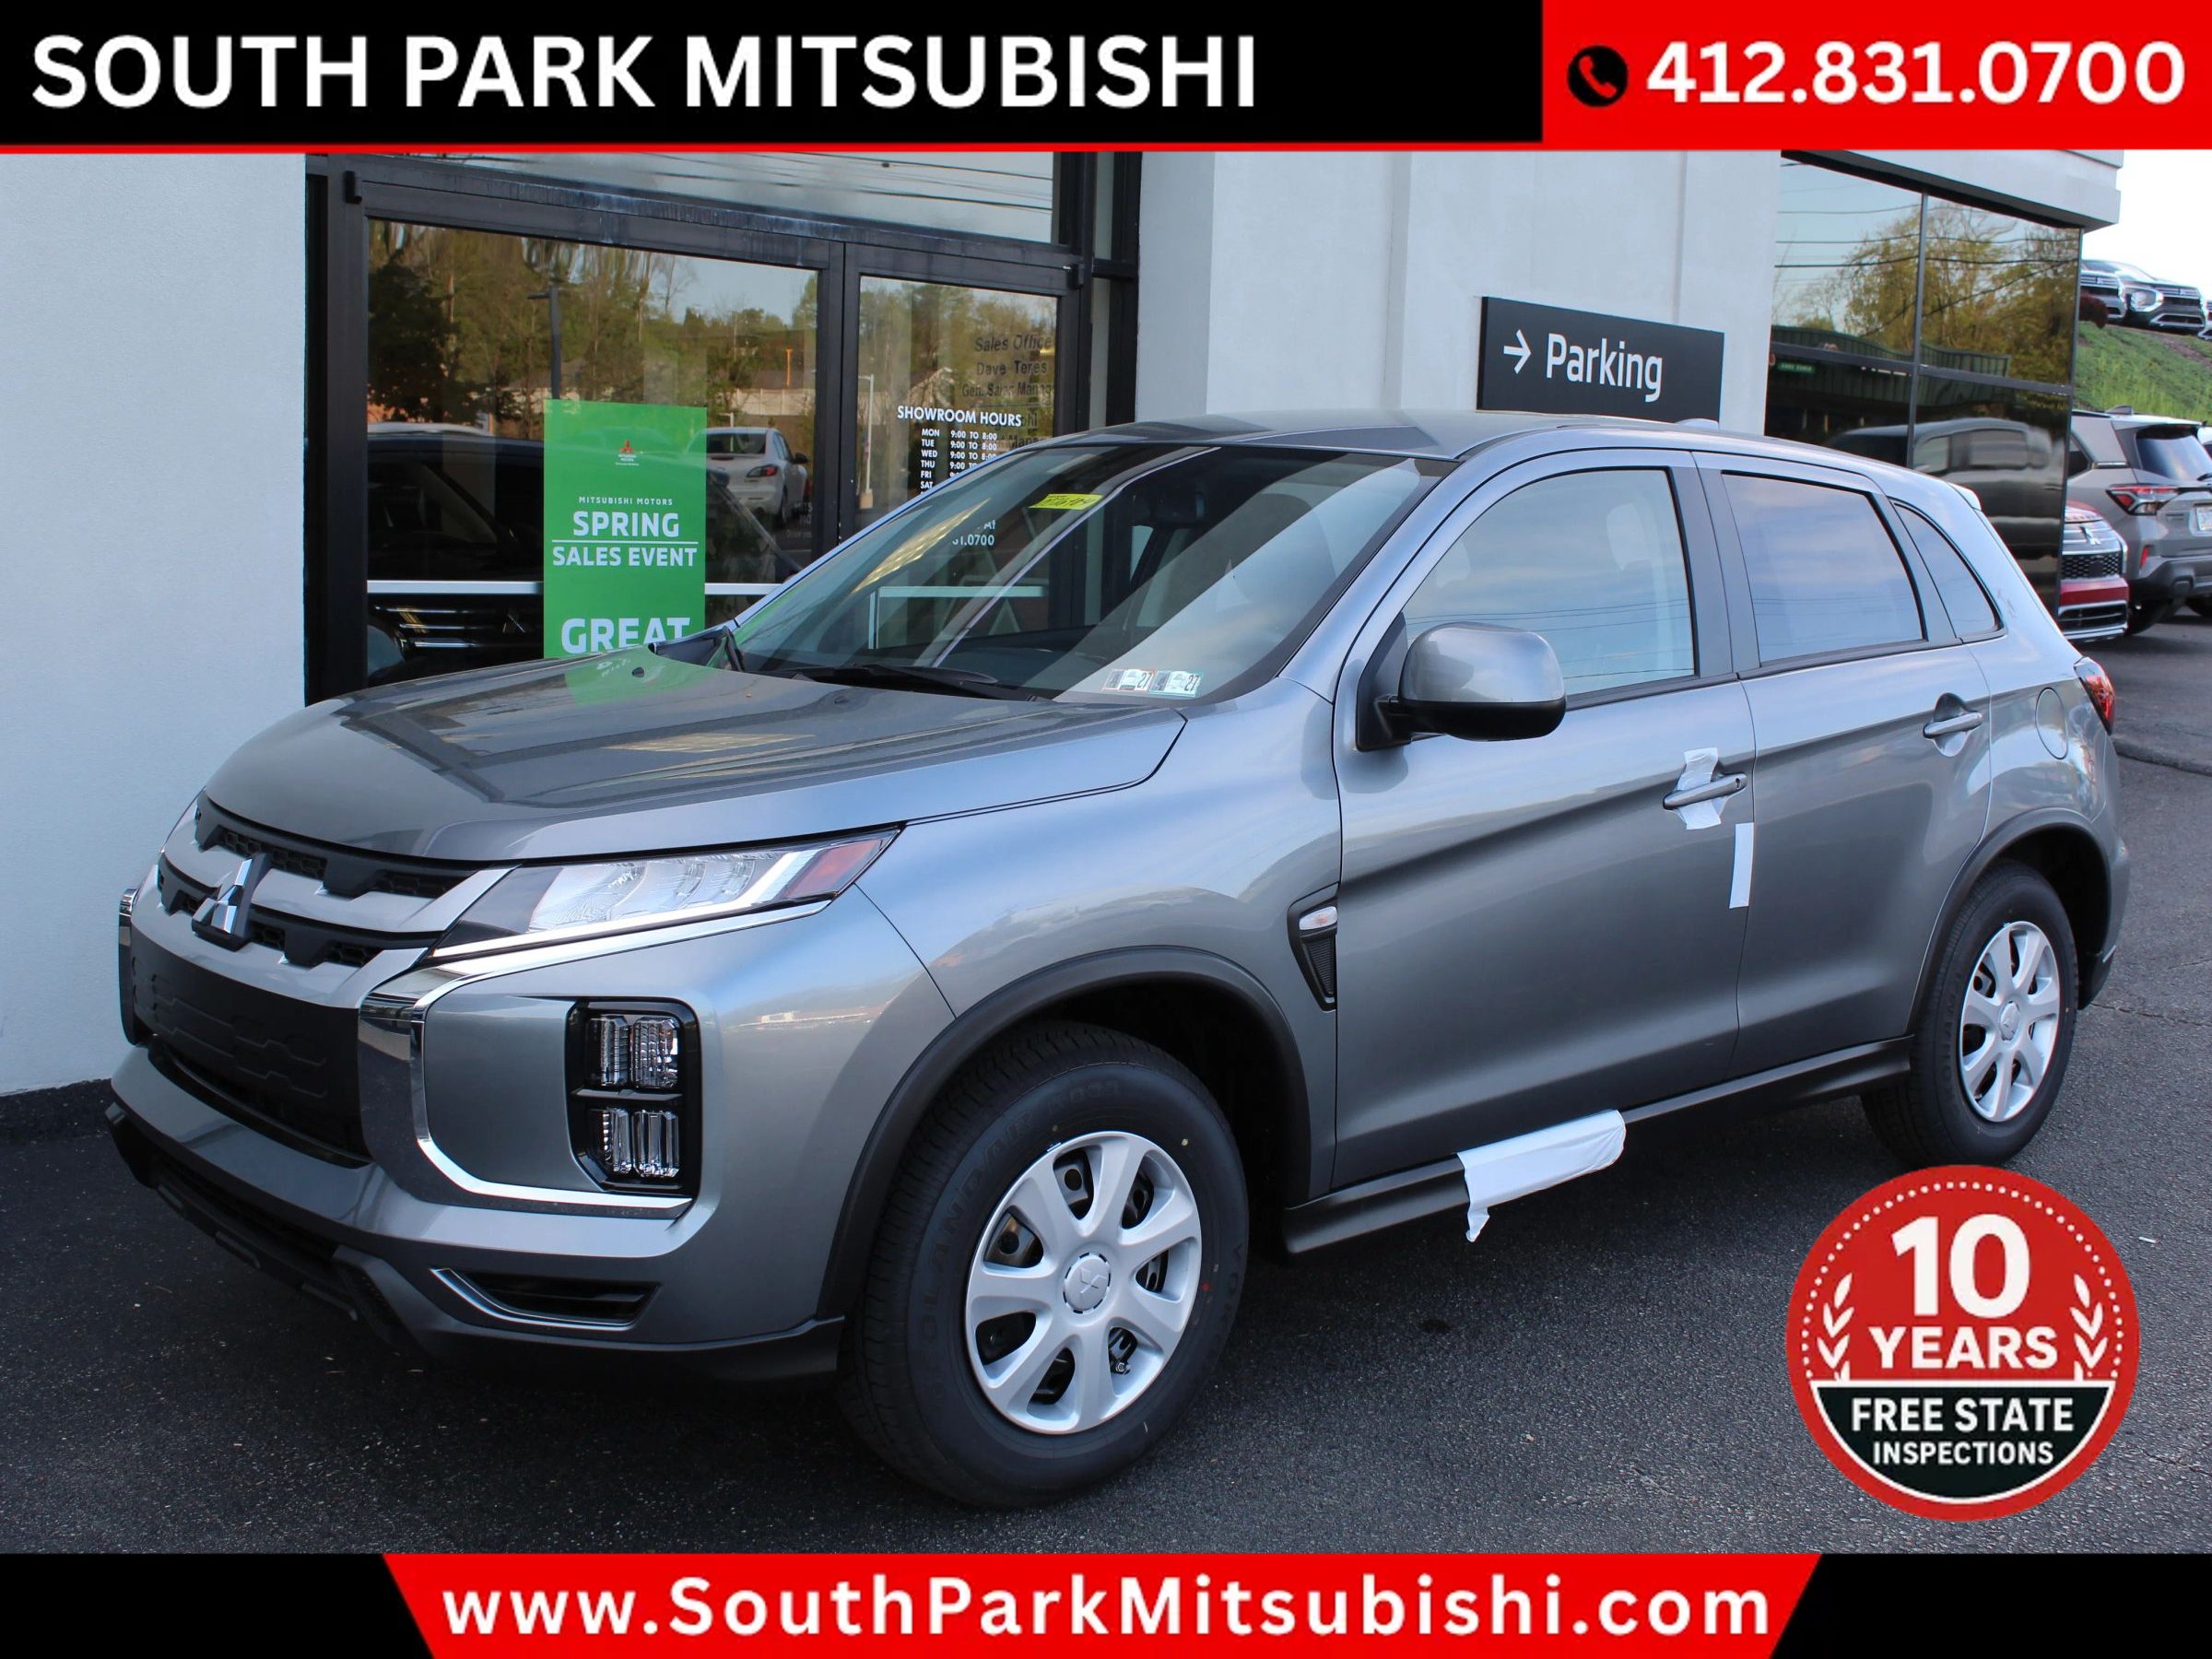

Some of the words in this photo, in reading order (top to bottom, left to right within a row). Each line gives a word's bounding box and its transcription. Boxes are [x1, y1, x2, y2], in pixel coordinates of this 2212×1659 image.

[974, 336, 1008, 352] Sales
[1013, 334, 1052, 350] Office
[977, 361, 1006, 376] Dave
[1546, 333, 1663, 403] Parking
[897, 405, 977, 424] SHOWROOM
[980, 411, 1022, 428] HOURS
[921, 429, 940, 437] MON
[950, 430, 966, 439] 9:00
[970, 431, 979, 440] TO
[982, 432, 997, 441] 8:00
[921, 439, 935, 447] TUE
[950, 441, 965, 449] 9:00
[969, 441, 978, 450] TO
[982, 442, 997, 451] 8:00
[921, 450, 938, 458] WED
[950, 451, 965, 460] 9:00
[968, 452, 978, 460] TO
[920, 460, 935, 468] THU
[949, 462, 965, 470] 9:00
[920, 470, 932, 478] FRI
[920, 481, 934, 489] SAT
[578, 496, 633, 505] MITSUBISHI
[636, 498, 673, 506] MOTORS
[573, 511, 679, 537] SPRING
[552, 546, 621, 566] SALES
[628, 547, 698, 567] EVENT
[560, 617, 691, 654] GREAT
[1136, 672, 1153, 688] 27
[1183, 674, 1200, 691] 27
